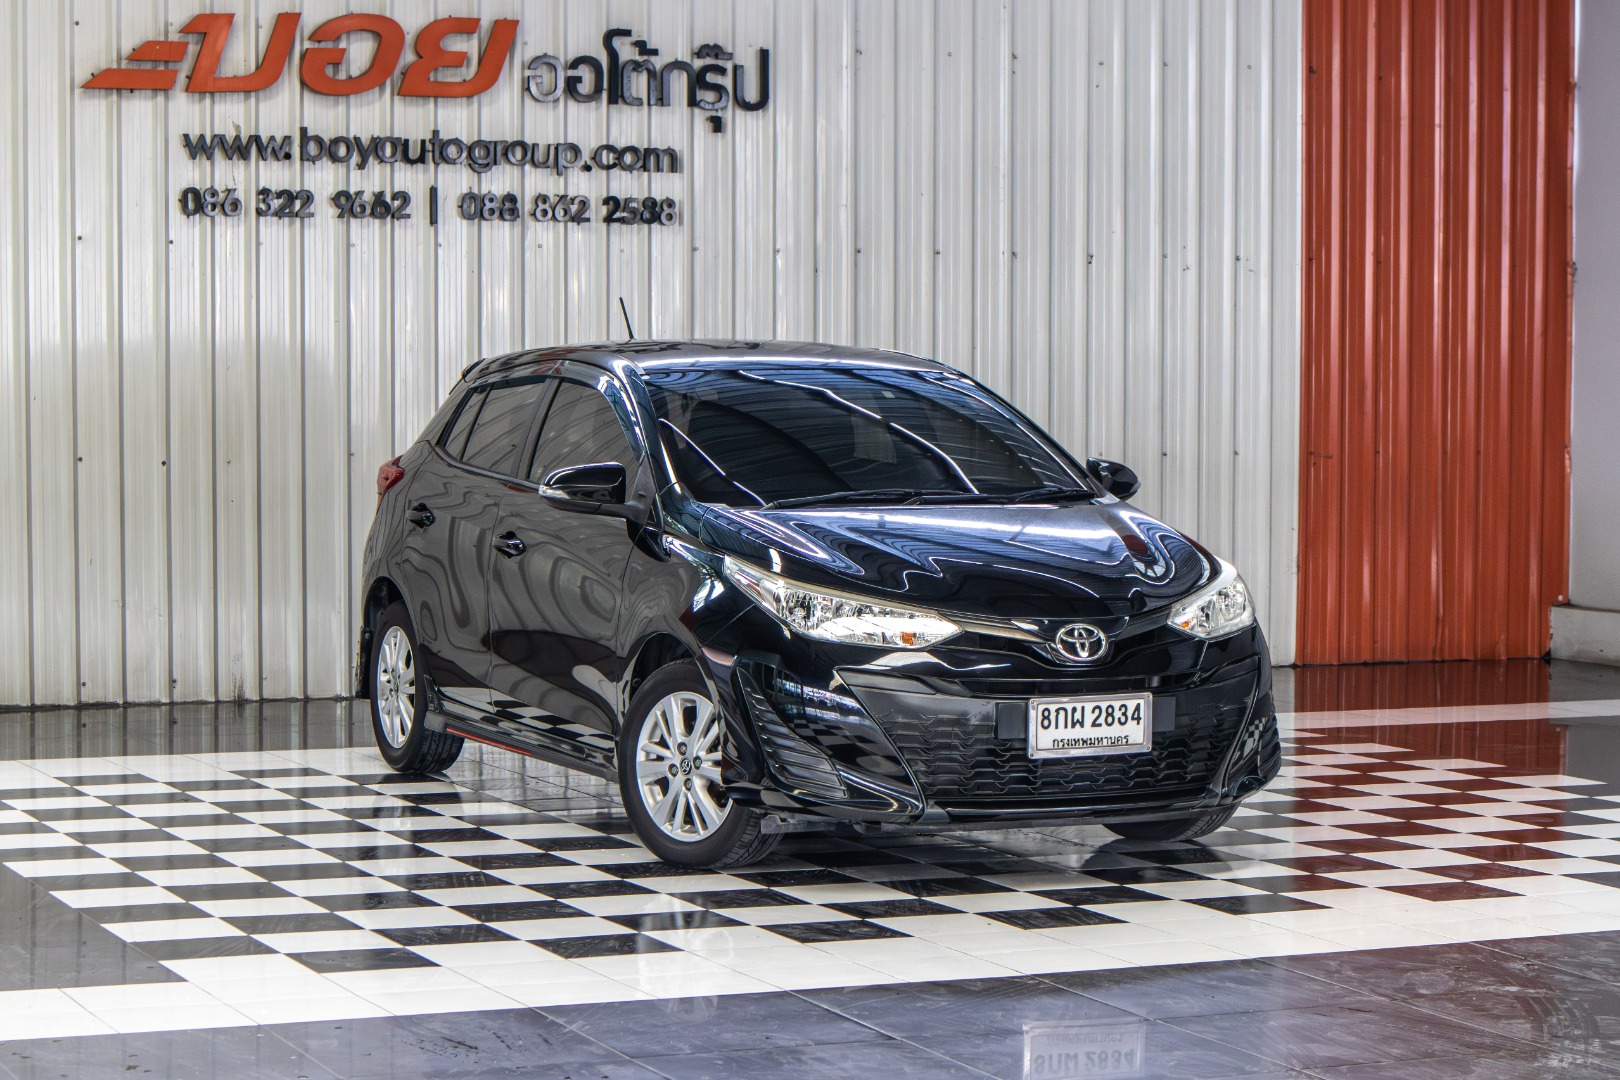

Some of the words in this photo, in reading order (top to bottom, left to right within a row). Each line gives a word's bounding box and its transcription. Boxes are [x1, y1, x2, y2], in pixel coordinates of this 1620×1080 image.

[178, 11, 520, 98] บอย
[527, 27, 770, 134] ออโต้กรุ๊ป
[182, 126, 679, 176] www.boyautogroup.com
[180, 186, 242, 217] 086
[256, 187, 315, 218] 322
[332, 189, 412, 218] 9662
[459, 191, 520, 221] 088
[533, 194, 591, 223] 862
[602, 195, 678, 226] 2588
[1040, 705, 1086, 730] 8กผ
[1091, 702, 1142, 727] 2834
